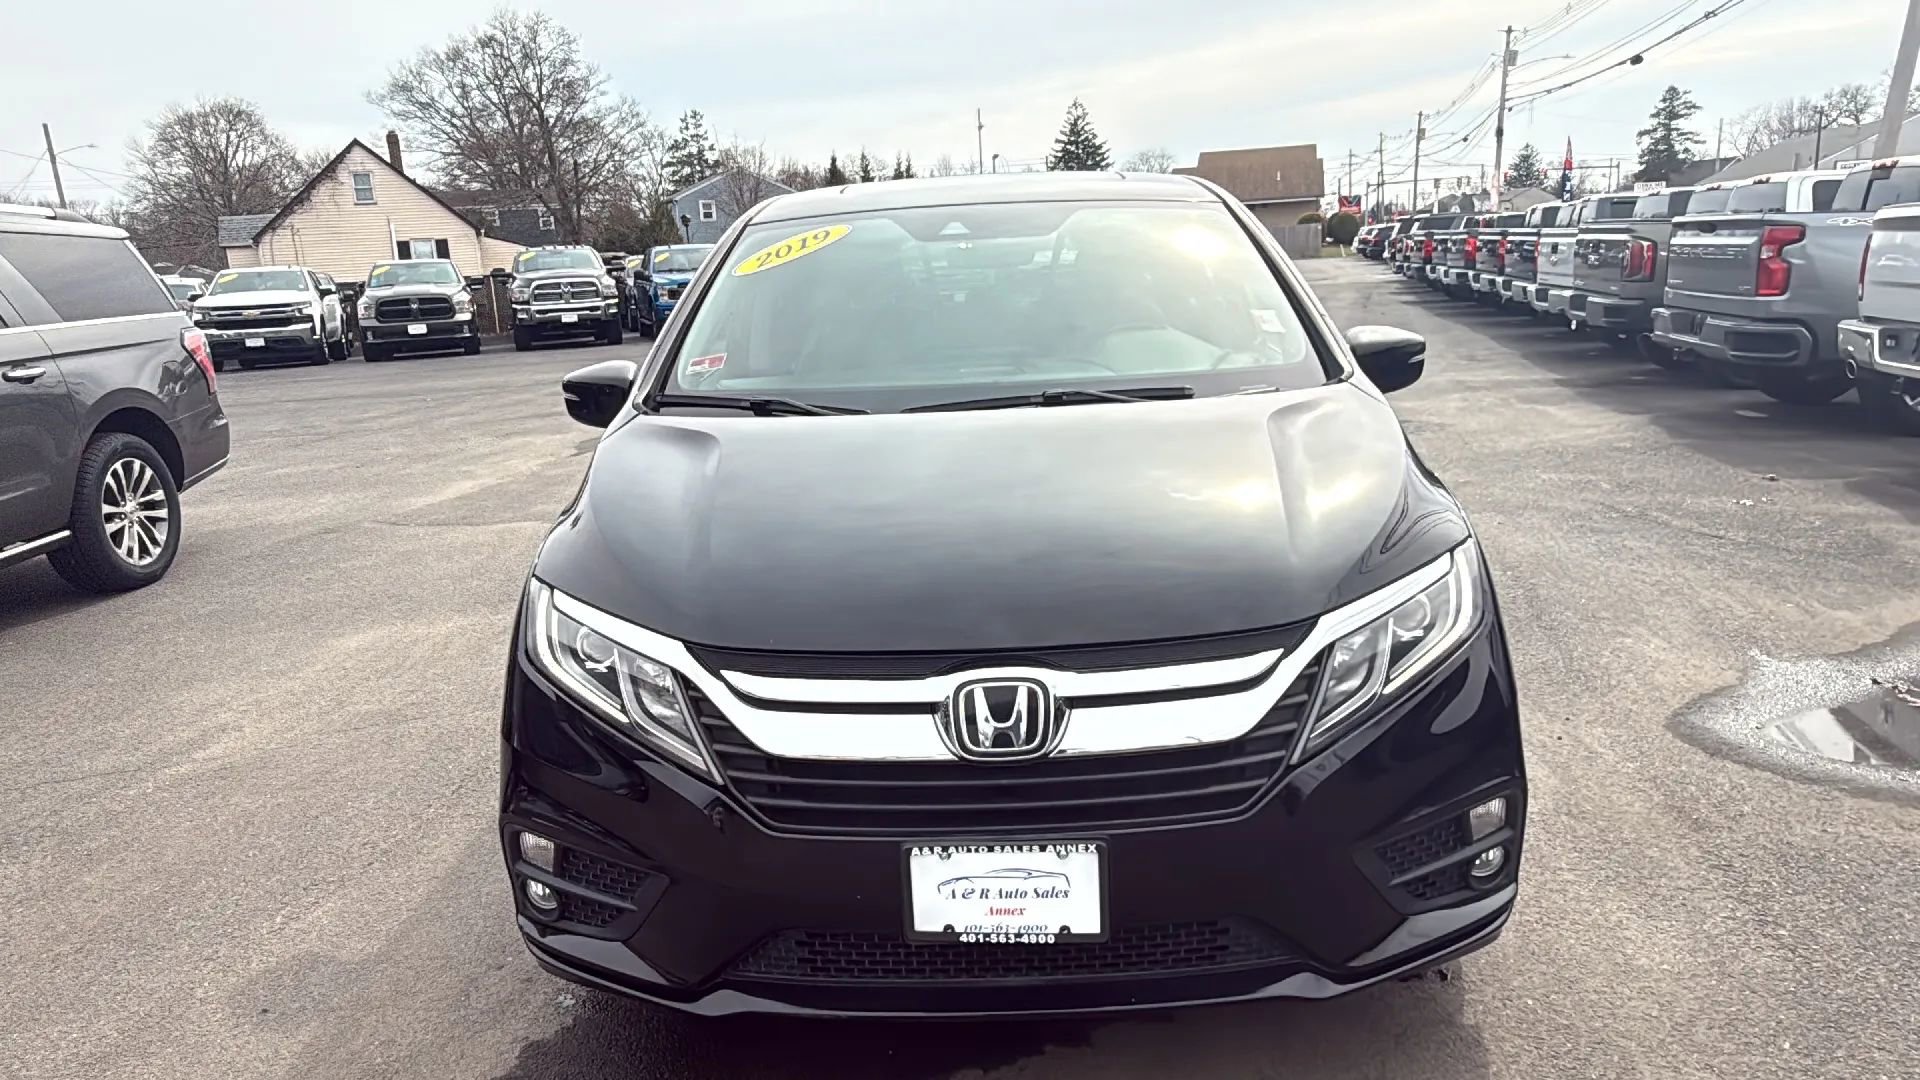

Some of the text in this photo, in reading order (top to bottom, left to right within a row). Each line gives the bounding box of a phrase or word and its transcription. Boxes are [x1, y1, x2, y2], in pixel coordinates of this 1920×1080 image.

[756, 229, 832, 269] 2019
[911, 843, 1097, 857] A&R AUTO SALES ANNEX
[961, 888, 976, 899] &
[979, 888, 990, 899] R
[993, 887, 1028, 899] Auto
[1031, 886, 1071, 899] Sales
[984, 905, 1027, 916] Annex
[959, 933, 1056, 944] 401-563-4900
